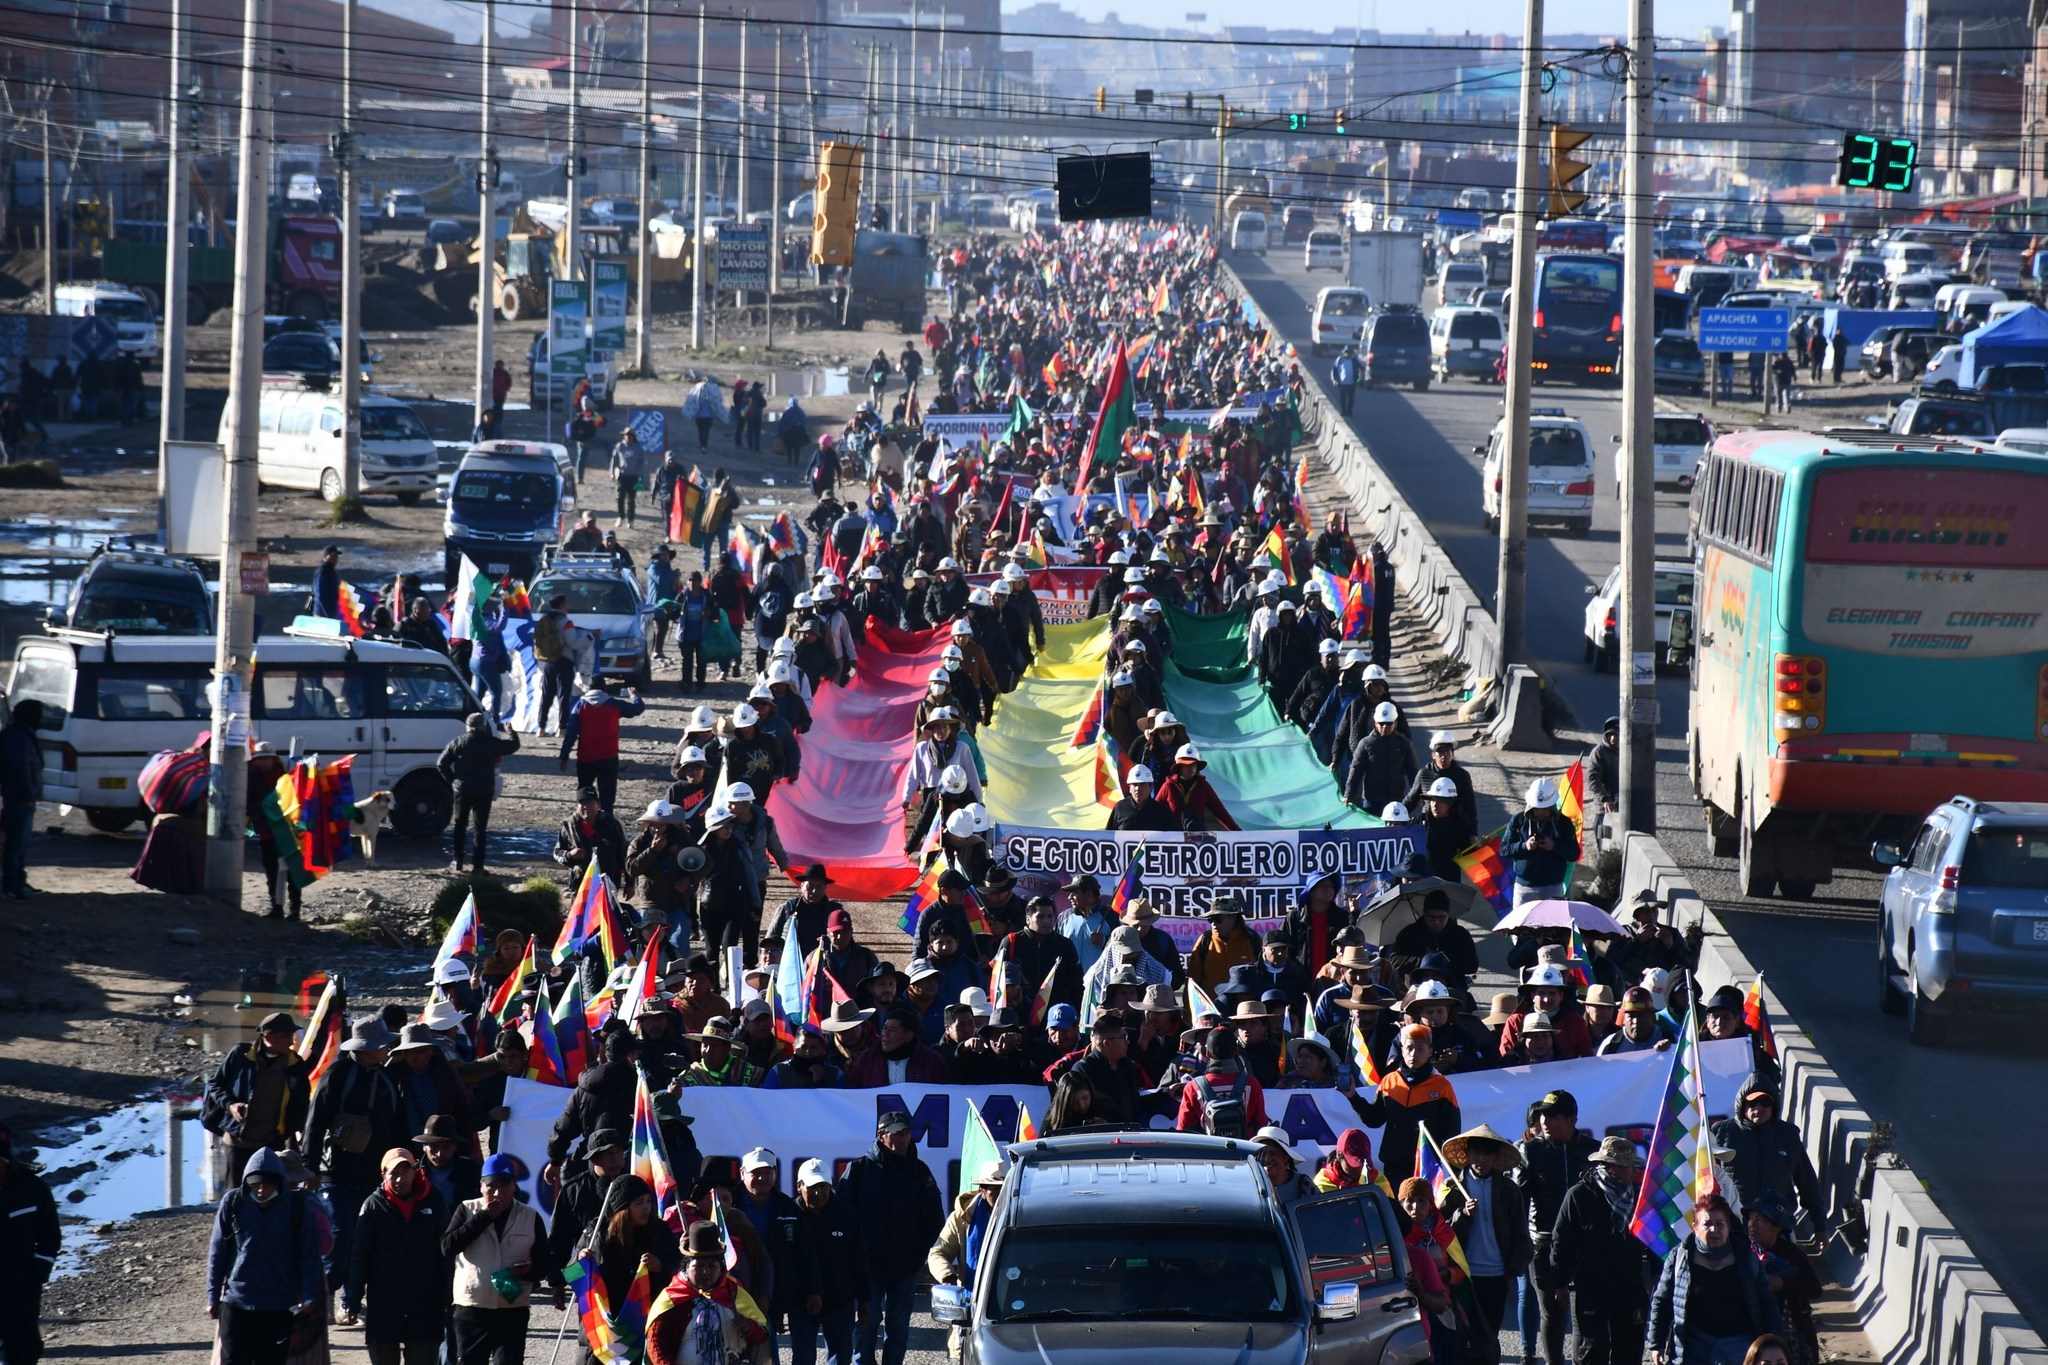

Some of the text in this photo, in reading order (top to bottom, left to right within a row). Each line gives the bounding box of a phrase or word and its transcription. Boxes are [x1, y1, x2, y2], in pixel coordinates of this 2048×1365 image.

[1848, 134, 1915, 191] 33
[723, 224, 763, 232] CAMBIO
[720, 243, 767, 252] MOTOR
[720, 260, 767, 269] LAVADO
[1706, 314, 1758, 324] APACHETA
[1705, 335, 1758, 346] MAZOCRUZ
[1826, 607, 2043, 629] ELEGANCIA CONFORT
[1888, 632, 1974, 651] TURISMO
[683, 788, 706, 811] NIKE
[1007, 836, 1121, 876] SECTOR
